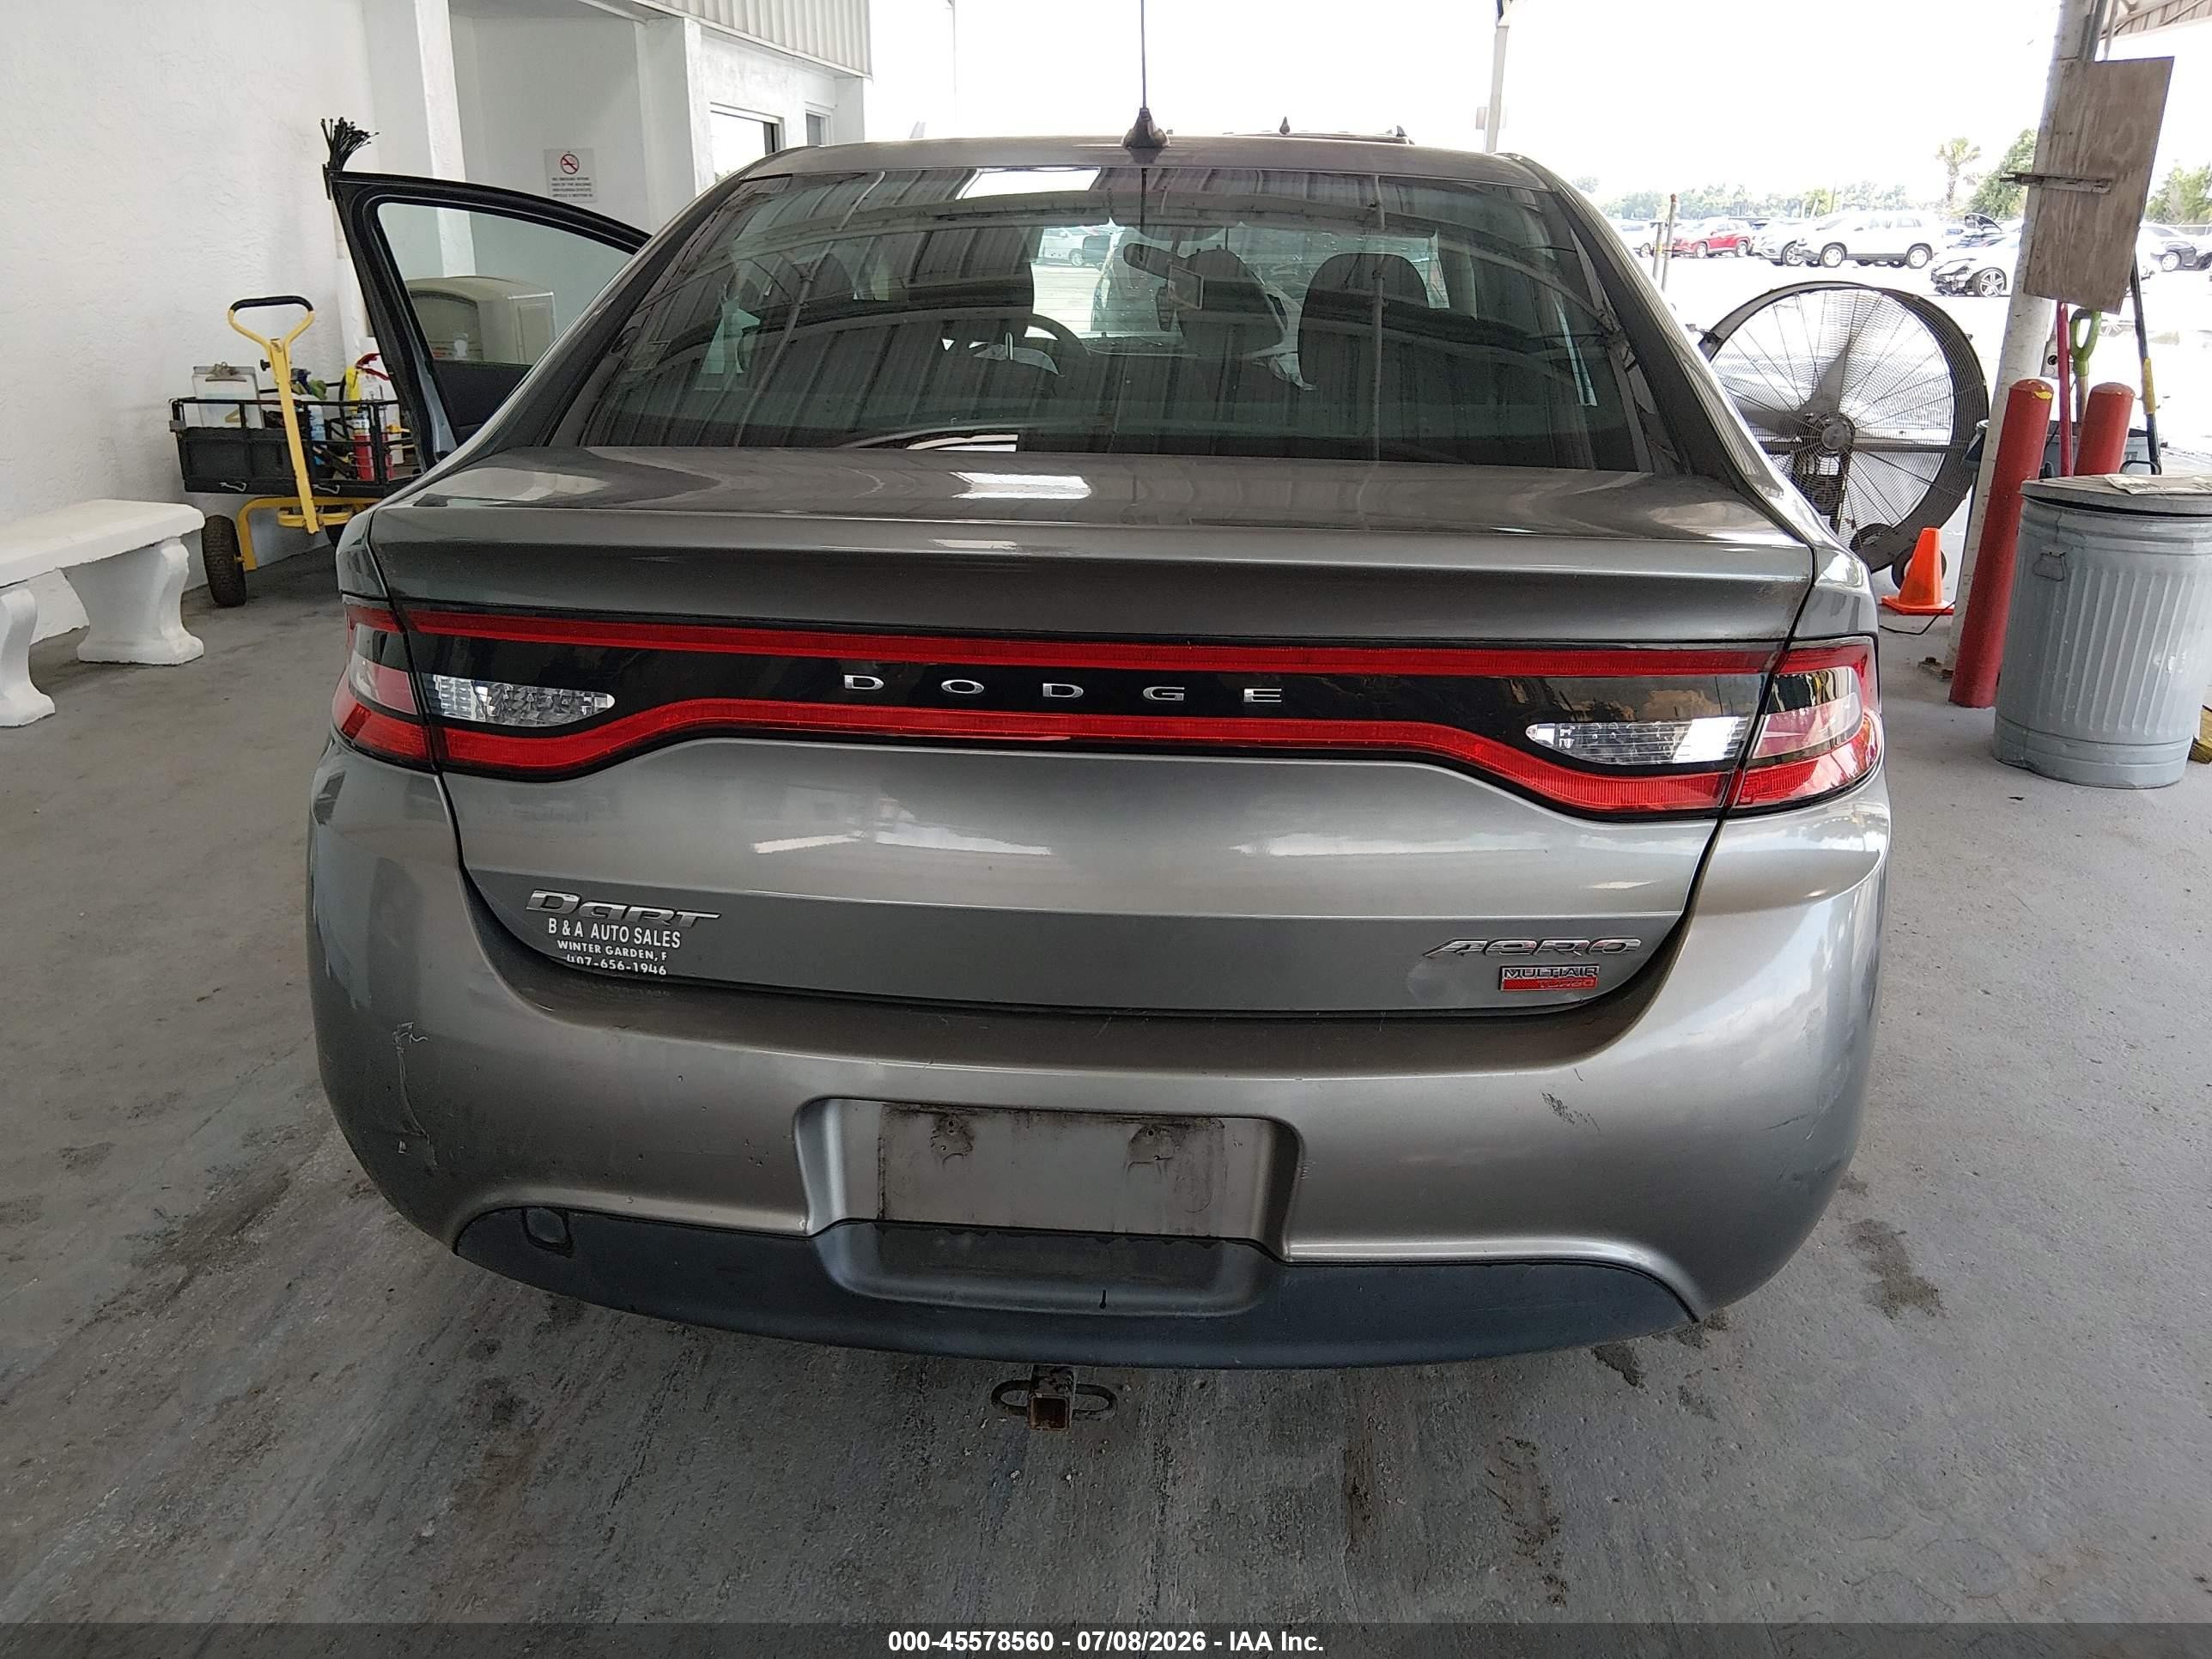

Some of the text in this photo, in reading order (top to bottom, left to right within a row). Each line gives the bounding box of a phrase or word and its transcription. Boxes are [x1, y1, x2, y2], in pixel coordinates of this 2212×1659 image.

[843, 674, 1283, 703] DODGE
[548, 918, 681, 949] B & A AUTO SALES
[557, 939, 601, 954] WINTER
[605, 945, 659, 962] GARDEN,
[1504, 967, 1598, 979] MULTIAIR
